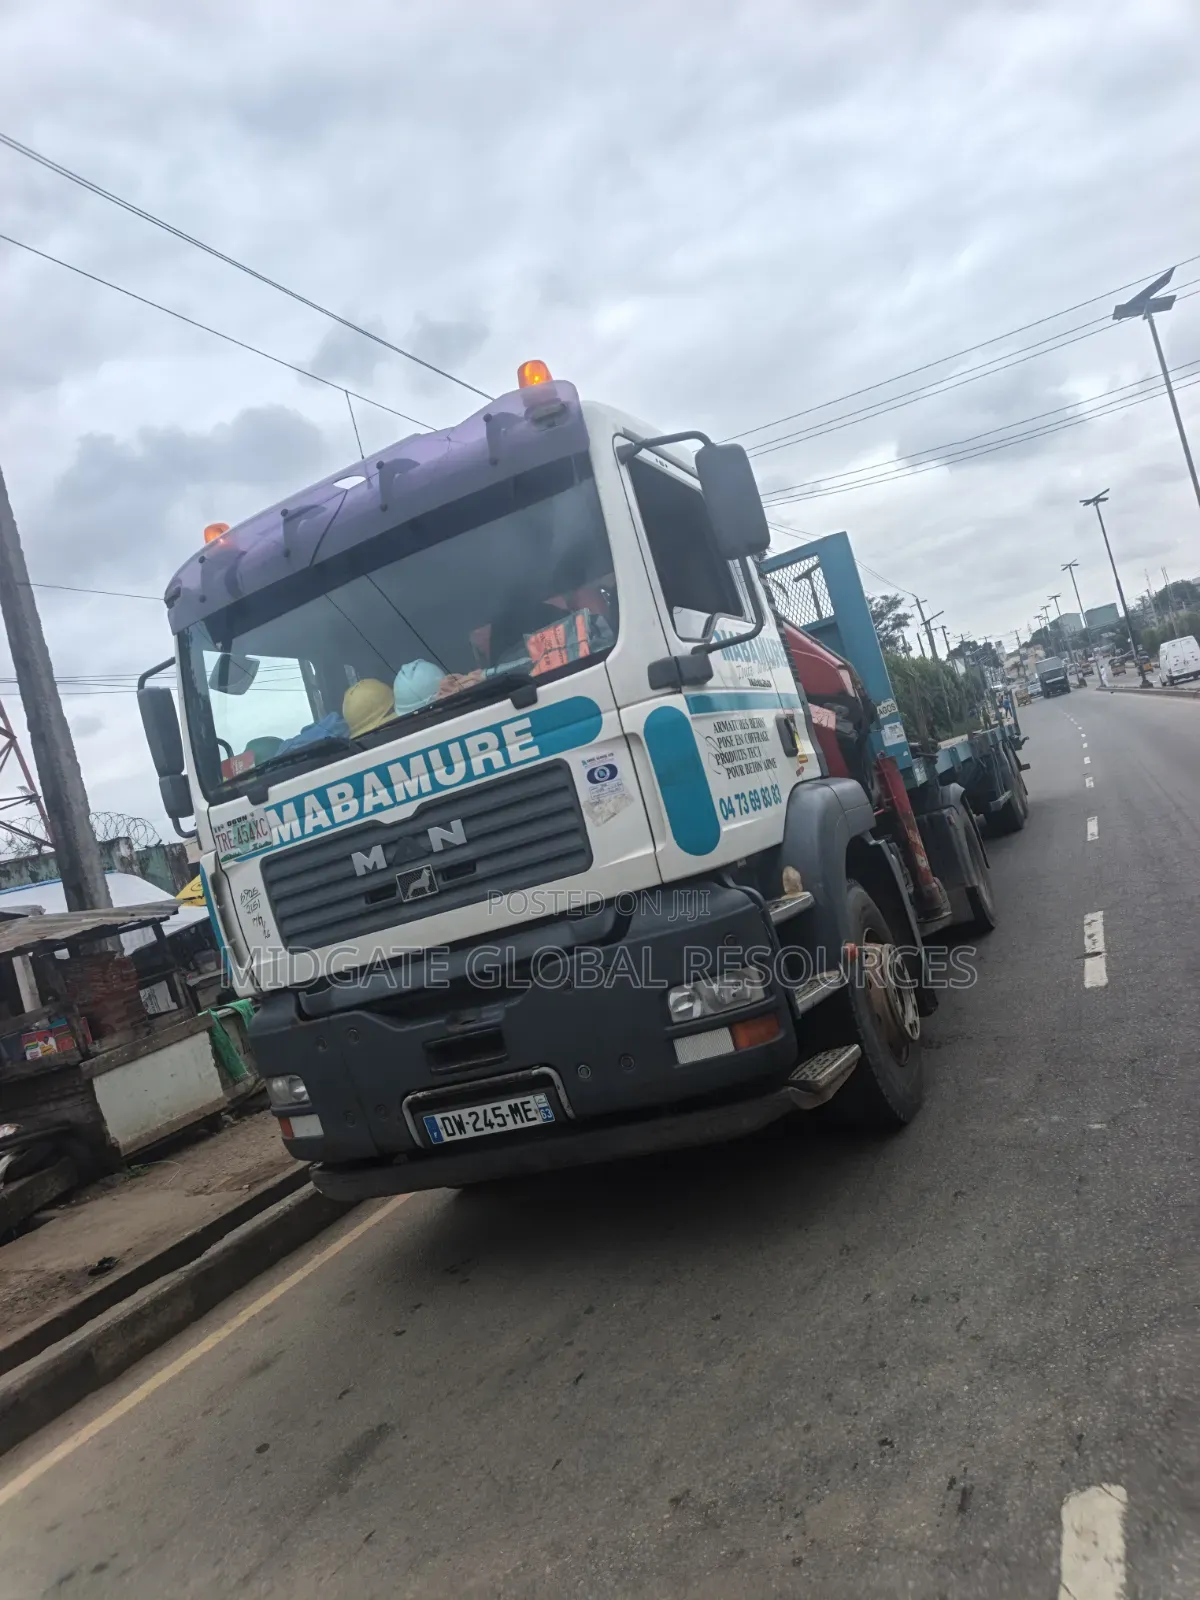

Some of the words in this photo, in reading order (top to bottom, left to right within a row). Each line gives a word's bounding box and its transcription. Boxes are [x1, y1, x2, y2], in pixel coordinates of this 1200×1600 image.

[713, 718, 750, 734] ARMATURES
[716, 734, 735, 749] POSE
[734, 733, 744, 746] EN
[744, 730, 770, 744] COFFRAGE
[714, 748, 747, 766] PRODUITS
[265, 717, 541, 846] MABAMURE
[726, 764, 745, 780] POUR
[719, 796, 736, 821] 04
[734, 792, 750, 816] 73
[748, 788, 761, 812] 69
[760, 786, 773, 808] 83
[770, 783, 782, 805] 83
[440, 1100, 537, 1138] DW-245-ME
[540, 1108, 553, 1120] 63
